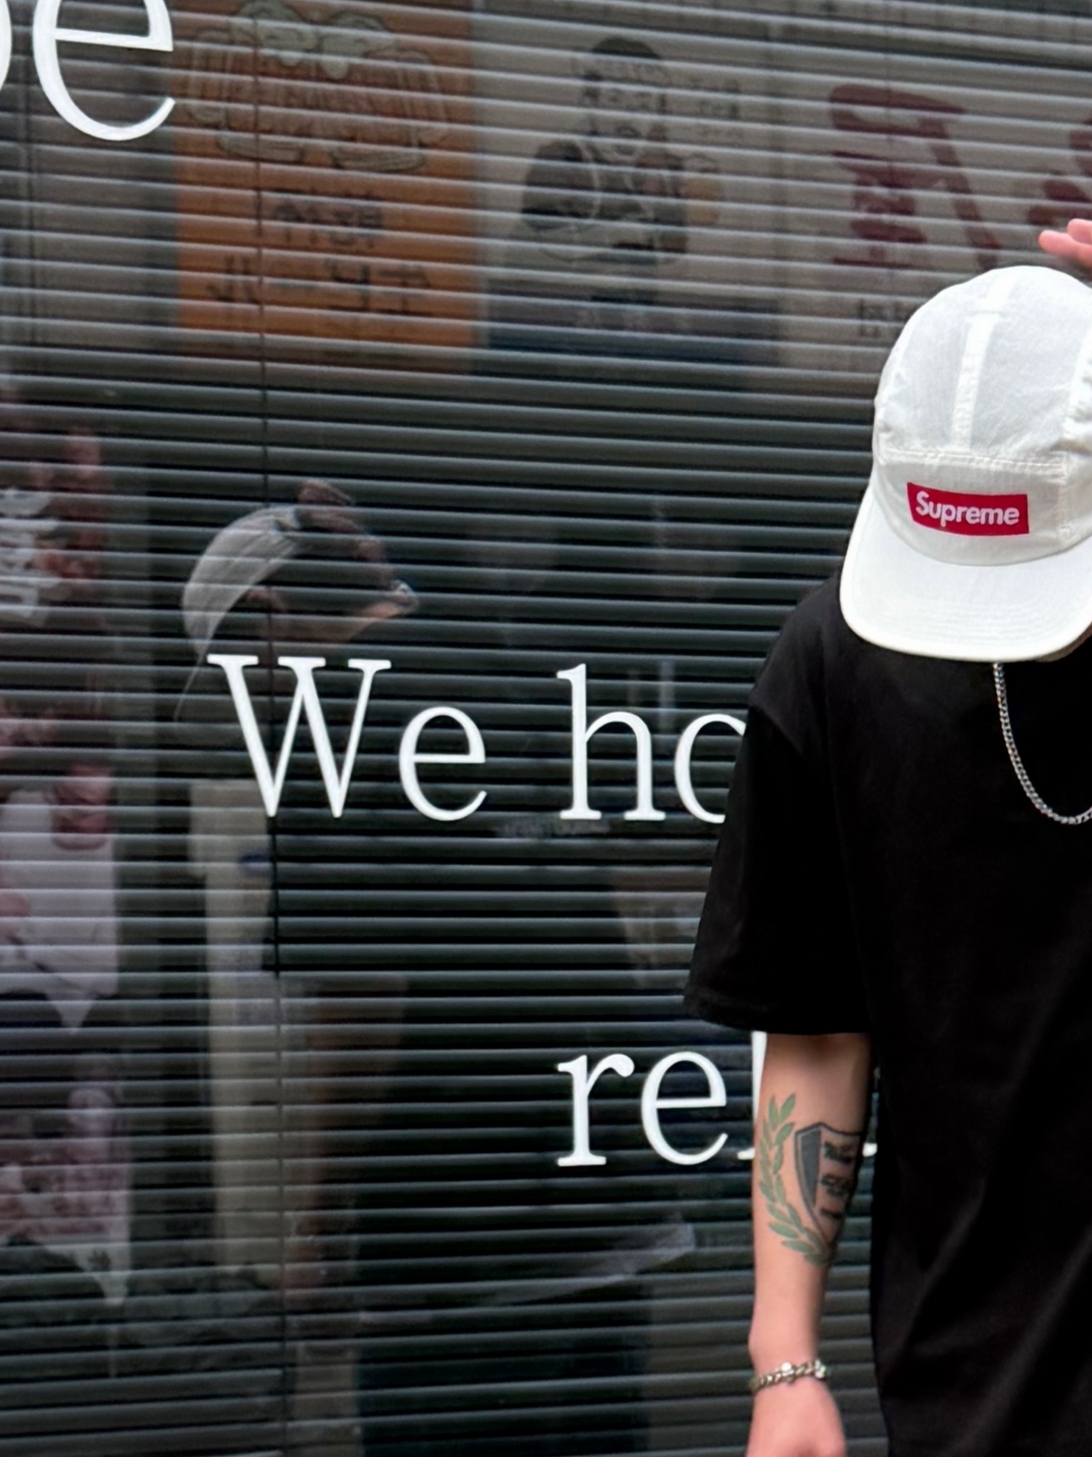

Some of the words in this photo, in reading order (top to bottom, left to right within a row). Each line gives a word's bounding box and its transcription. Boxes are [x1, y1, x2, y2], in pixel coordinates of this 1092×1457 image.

[915, 490, 1020, 528] Supreme
[207, 653, 487, 821] We
[557, 663, 747, 825] ho
